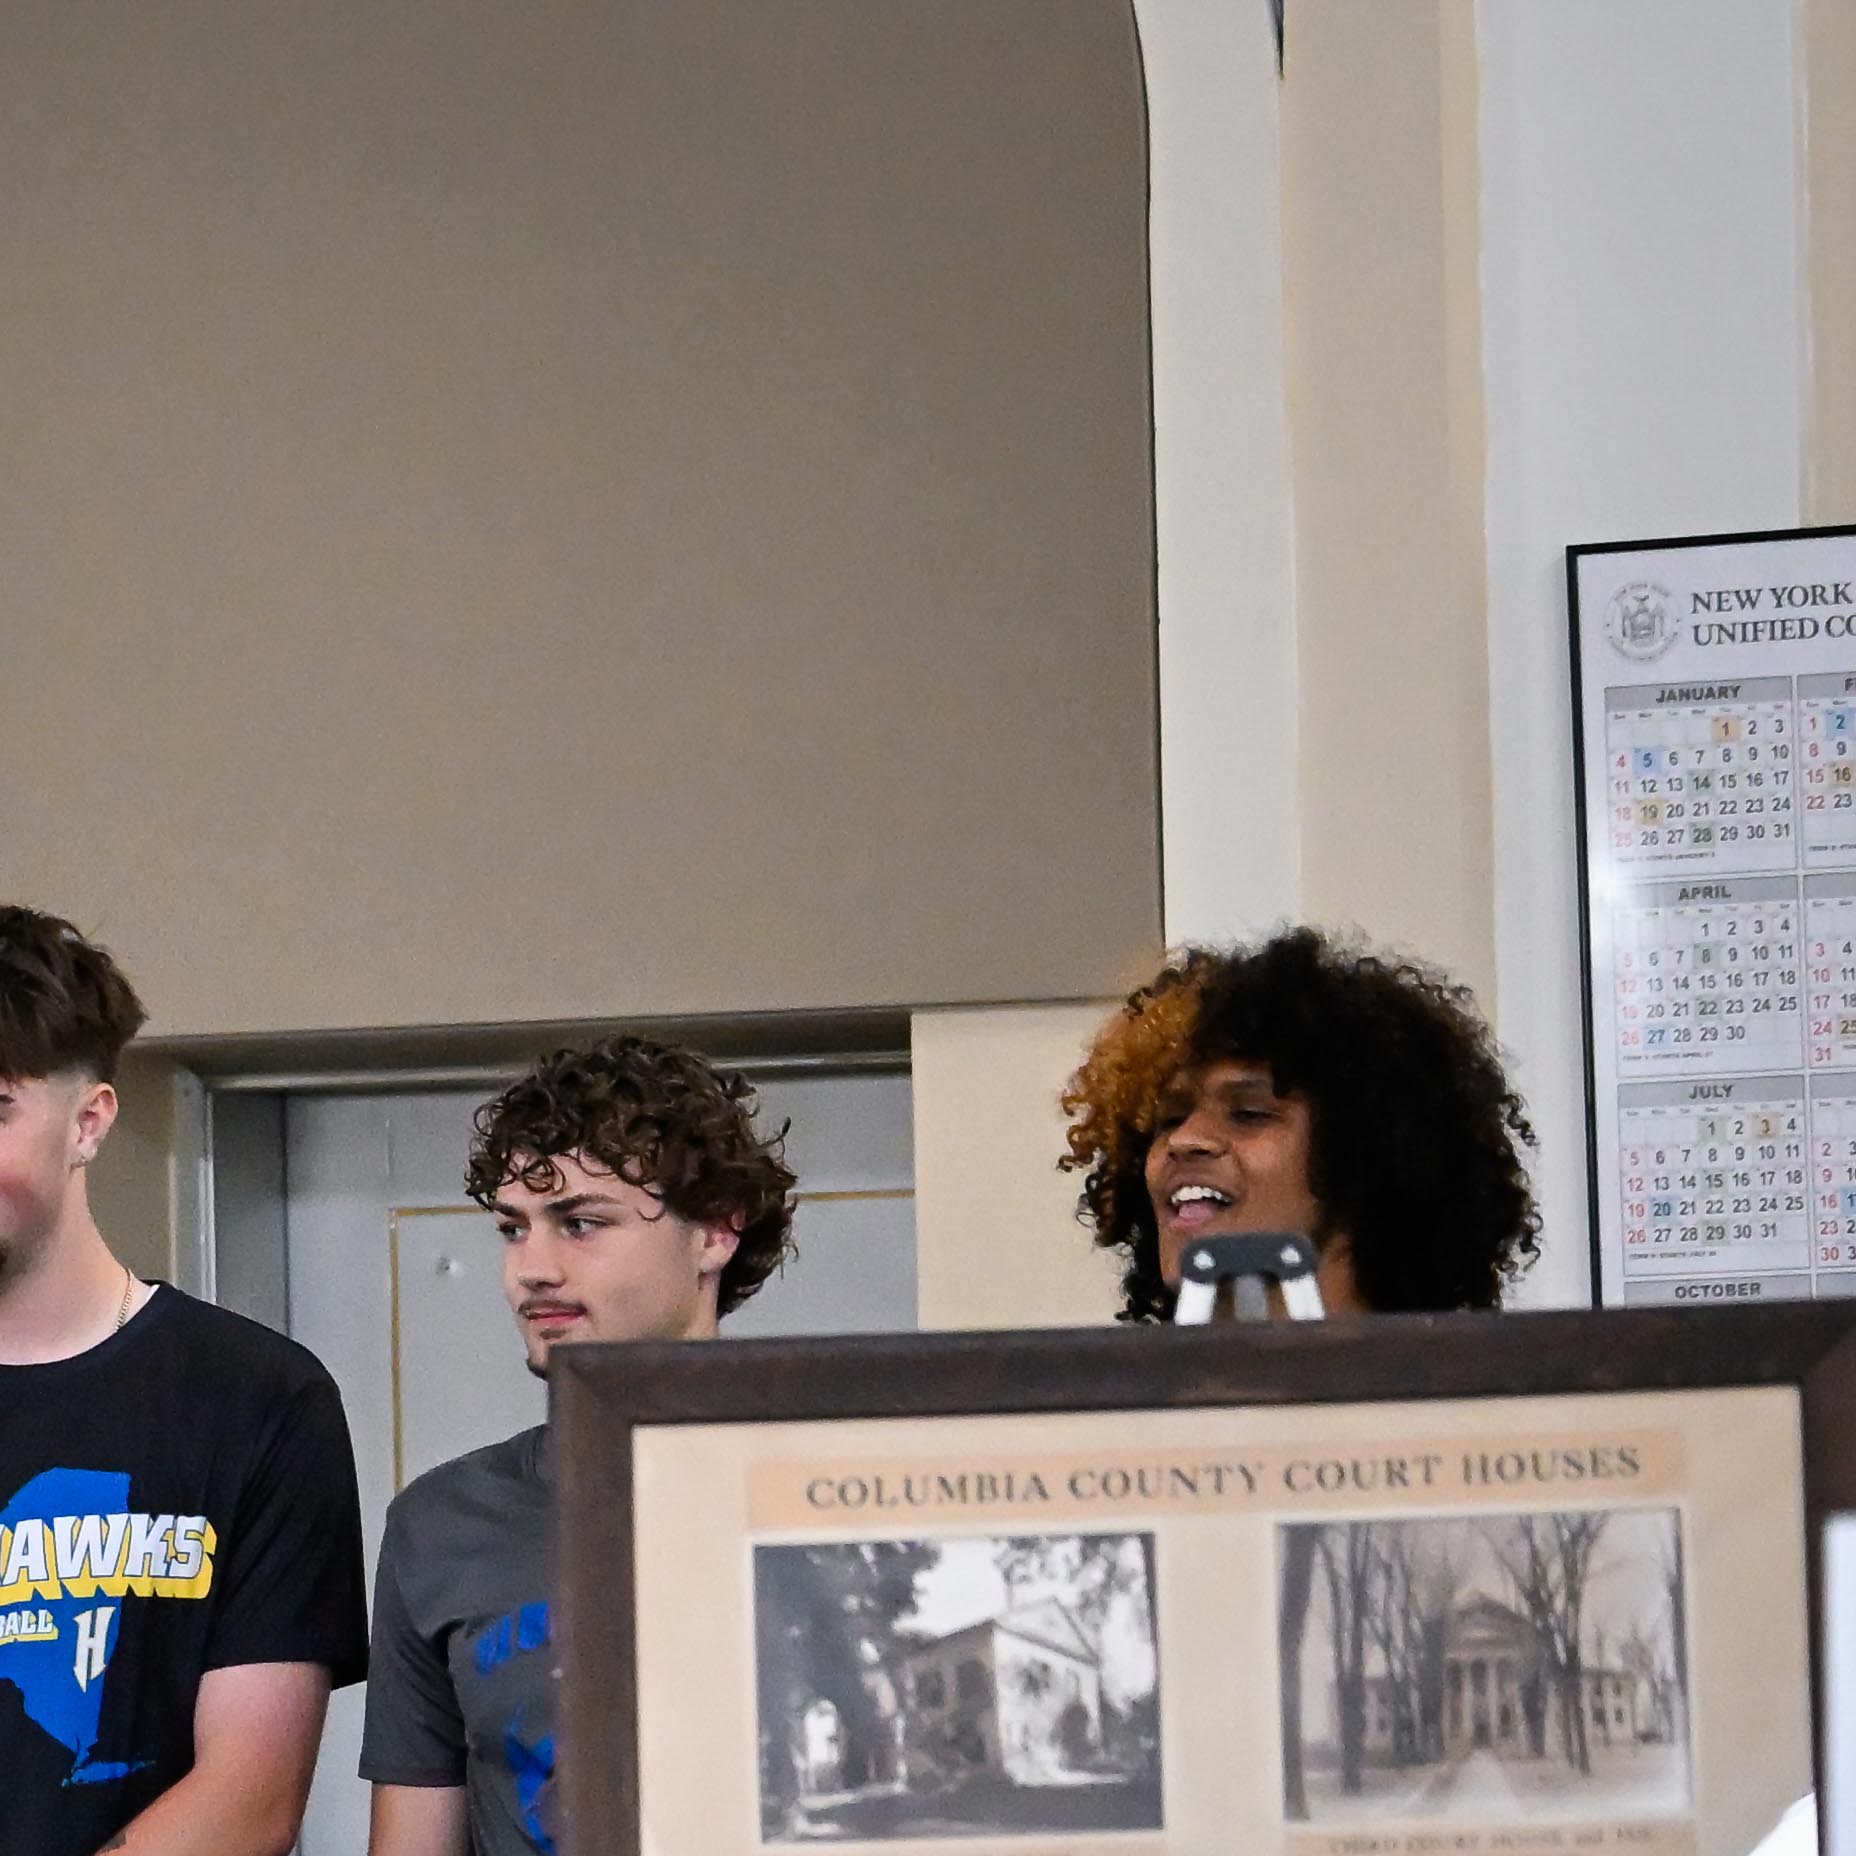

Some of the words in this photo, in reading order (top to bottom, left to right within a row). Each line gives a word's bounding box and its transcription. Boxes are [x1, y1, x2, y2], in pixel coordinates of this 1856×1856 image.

[1690, 587, 1763, 614] NEW
[1769, 581, 1854, 609] YORK
[1691, 616, 1820, 647] UNIFIED
[1655, 685, 1741, 704] JANUARY
[1721, 721, 1730, 737] 1
[1747, 719, 1757, 736] 2
[1774, 718, 1784, 734] 3
[1835, 714, 1846, 730] 2
[1642, 752, 1653, 769] 5
[1668, 751, 1679, 766] 6
[1695, 749, 1705, 765] 7
[1722, 747, 1732, 763] 8
[1748, 746, 1758, 761] 9
[1771, 743, 1790, 760] 10
[1836, 741, 1847, 756] 9
[1640, 778, 1658, 794] 12
[1666, 777, 1684, 792] 13
[1692, 775, 1712, 791] 14
[1719, 772, 1737, 789] 15
[1745, 772, 1764, 787] 16
[1773, 770, 1790, 786] 17
[1640, 804, 1659, 820] 19
[1666, 803, 1685, 819] 20
[1692, 801, 1710, 817] 21
[1719, 800, 1738, 816] 22
[1745, 798, 1764, 814] 23
[1771, 796, 1791, 812] 24
[1833, 793, 1853, 809] 23
[1640, 830, 1660, 846] 26
[1666, 828, 1685, 845] 27
[1719, 825, 1739, 842] 29
[1746, 824, 1766, 840] 30
[1773, 822, 1791, 839] 31
[1678, 885, 1732, 901] APRIL
[1701, 922, 1710, 937] 1
[1727, 920, 1737, 936] 2
[1754, 919, 1764, 935] 3
[1780, 918, 1791, 932] 4
[1675, 949, 1685, 965] 7
[1727, 946, 1738, 962] 9
[1751, 945, 1769, 961] 10
[1777, 944, 1793, 959] 11
[1842, 941, 1853, 955] 4
[1647, 976, 1664, 993] 13
[1672, 975, 1690, 990] 14
[1698, 974, 1717, 990] 15
[1726, 972, 1744, 988] 16
[1752, 970, 1770, 987] 17
[1778, 969, 1796, 985] 18
[1646, 1002, 1665, 1019] 20
[1672, 1001, 1689, 1018] 21
[1698, 1000, 1718, 1016] 22
[1725, 998, 1745, 1015] 23
[1752, 998, 1772, 1014] 24
[1778, 996, 1797, 1012] 25
[1647, 1028, 1666, 1045] 27
[1673, 1027, 1692, 1043] 28
[1699, 1026, 1719, 1042] 29
[1726, 1025, 1746, 1041] 30
[1689, 1083, 1734, 1100] JULY
[1707, 1120, 1716, 1136] 1
[1734, 1120, 1744, 1135] 2
[1786, 1117, 1797, 1132] 4
[1630, 1151, 1640, 1167] 5
[1655, 1150, 1665, 1165] 6
[1681, 1148, 1691, 1163] 7
[1707, 1147, 1718, 1163] 8
[1734, 1146, 1746, 1162] 9
[1758, 1144, 1776, 1160] 10
[1785, 1143, 1800, 1158] 11
[1626, 1176, 1644, 1192] 12
[1653, 1176, 1670, 1191] 13
[1679, 1174, 1697, 1189] 14
[1704, 1173, 1724, 1189] 15
[1732, 1172, 1751, 1187] 16
[1759, 1170, 1776, 1186] 17
[1785, 1169, 1803, 1185] 18
[1653, 1201, 1672, 1217] 20
[1679, 1200, 1696, 1216] 21
[1705, 1199, 1725, 1215] 22
[1732, 1198, 1752, 1214] 23
[1758, 1197, 1778, 1212] 24
[1784, 1195, 1804, 1211] 25
[1627, 1229, 1647, 1245] 26
[1653, 1227, 1672, 1243] 27
[1679, 1226, 1698, 1242] 28
[1706, 1225, 1726, 1241] 29
[1733, 1224, 1752, 1240] 30
[1759, 1222, 1777, 1238] 31
[1674, 1281, 1762, 1299] OCTOBER
[805, 1472, 1051, 1510] COLUMBIA
[1066, 1460, 1264, 1501] COUNTY
[1284, 1452, 1445, 1494] COURT
[1461, 1445, 1642, 1488] HOUSES
[73, 1606, 117, 1693] H
